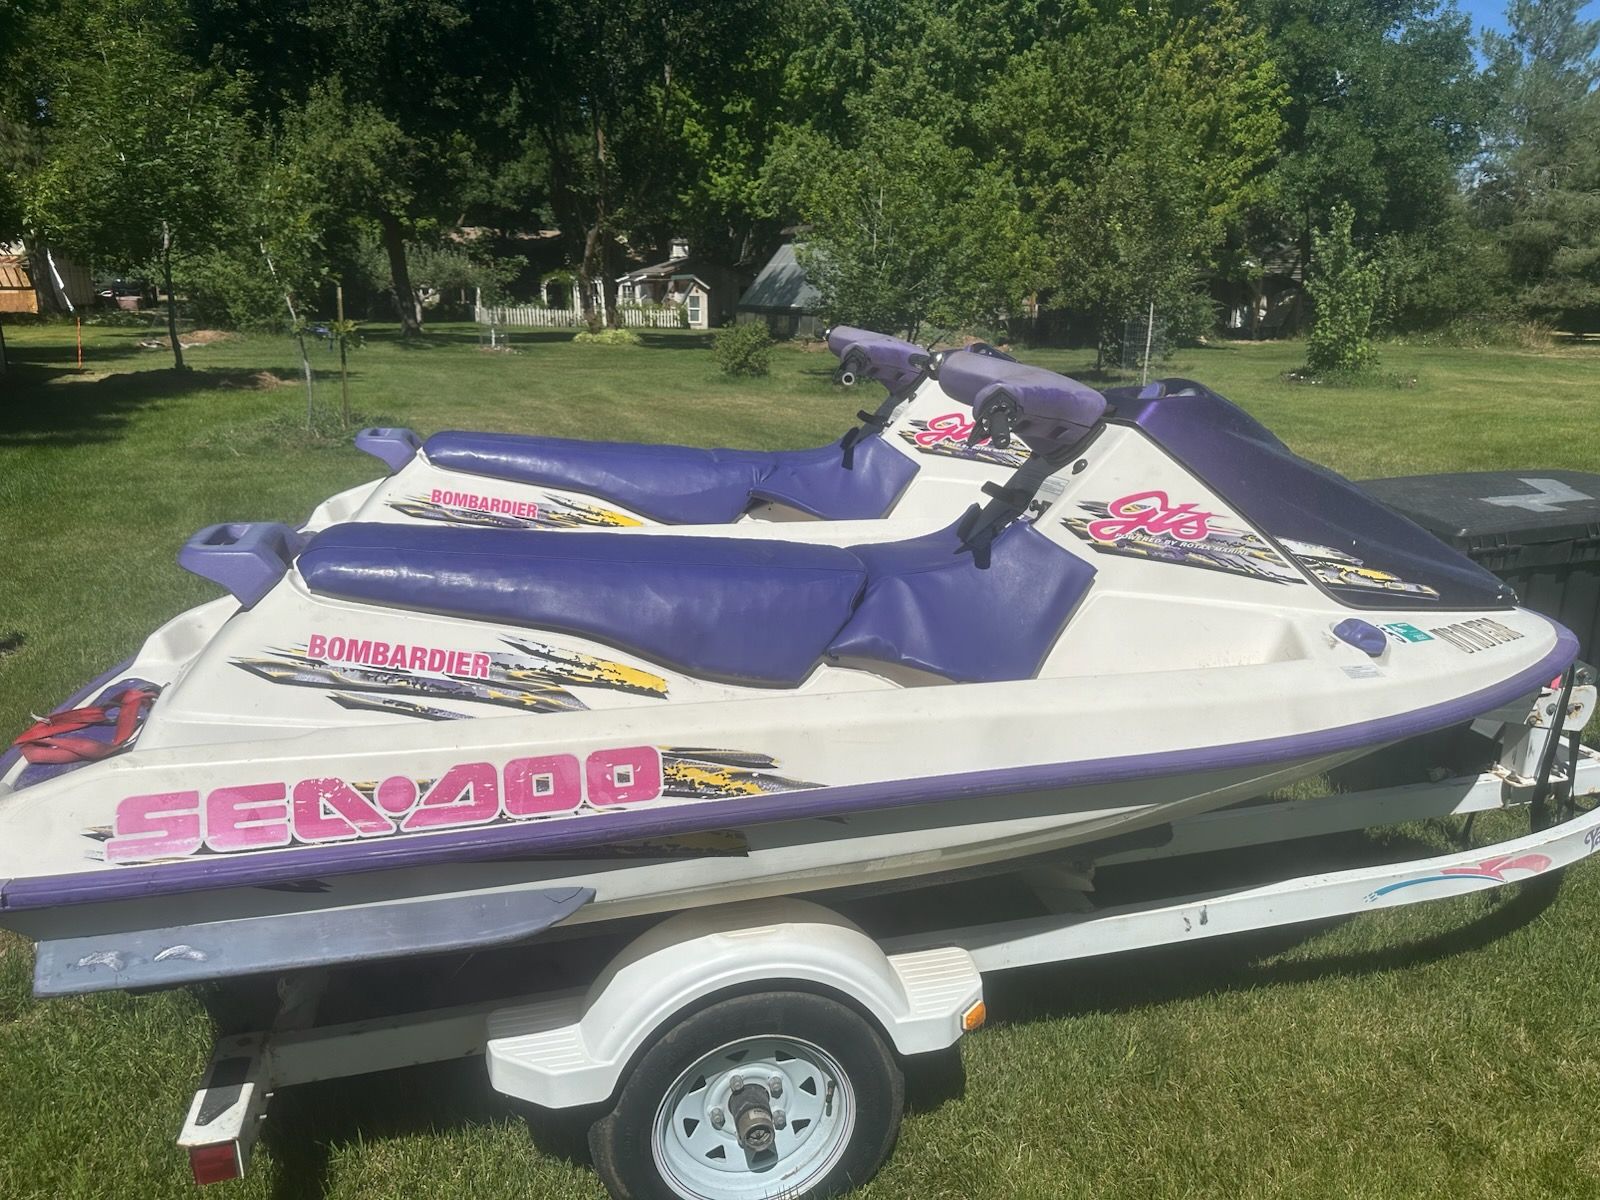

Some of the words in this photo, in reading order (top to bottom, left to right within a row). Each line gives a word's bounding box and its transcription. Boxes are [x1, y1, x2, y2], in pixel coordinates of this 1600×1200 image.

[430, 489, 538, 518] BOMBARDIER
[1114, 532, 1162, 543] POWERED
[1164, 539, 1179, 547] BY
[1180, 541, 1211, 551] ROTAX
[307, 634, 491, 678] BOMBARDIER
